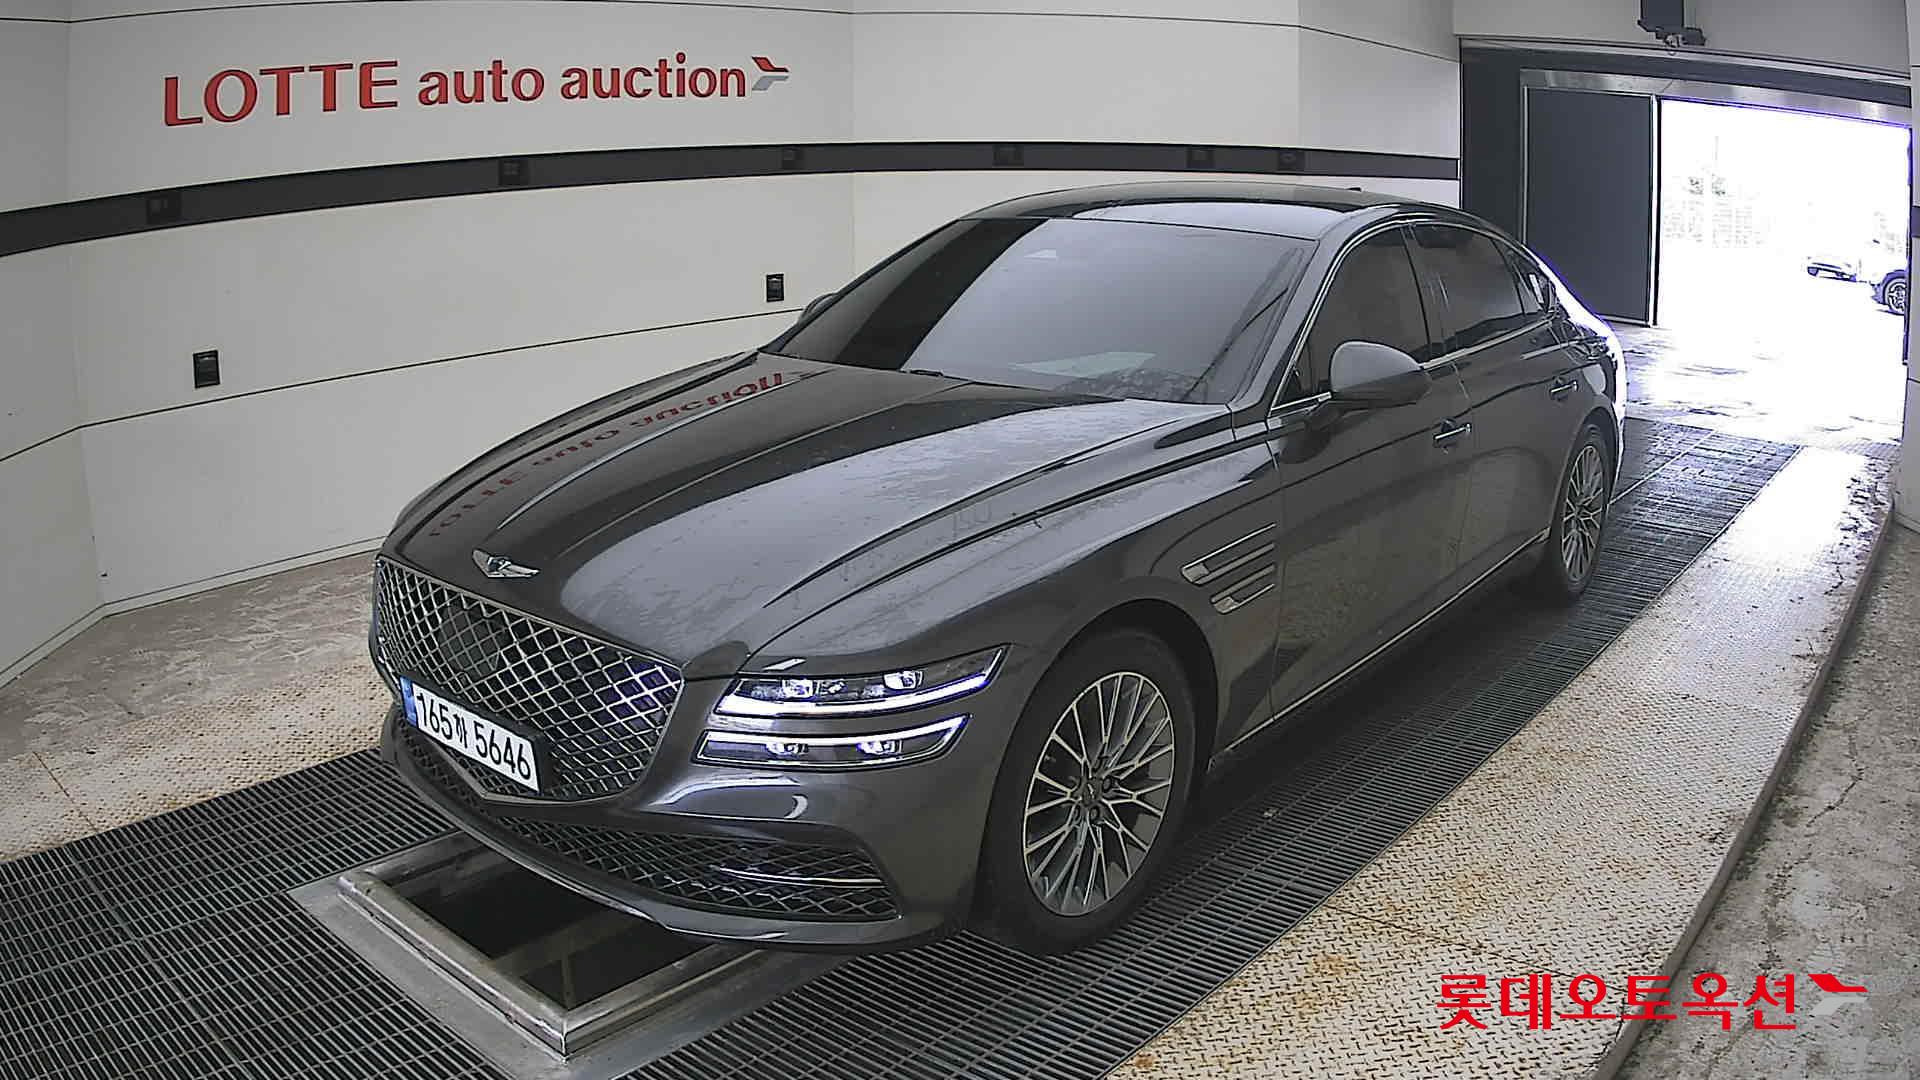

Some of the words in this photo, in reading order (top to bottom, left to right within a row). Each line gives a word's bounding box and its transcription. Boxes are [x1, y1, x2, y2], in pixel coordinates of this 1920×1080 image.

[163, 60, 399, 127] LOTTE
[417, 59, 545, 106] auto
[560, 51, 747, 99] auction
[473, 719, 531, 780] 5646
